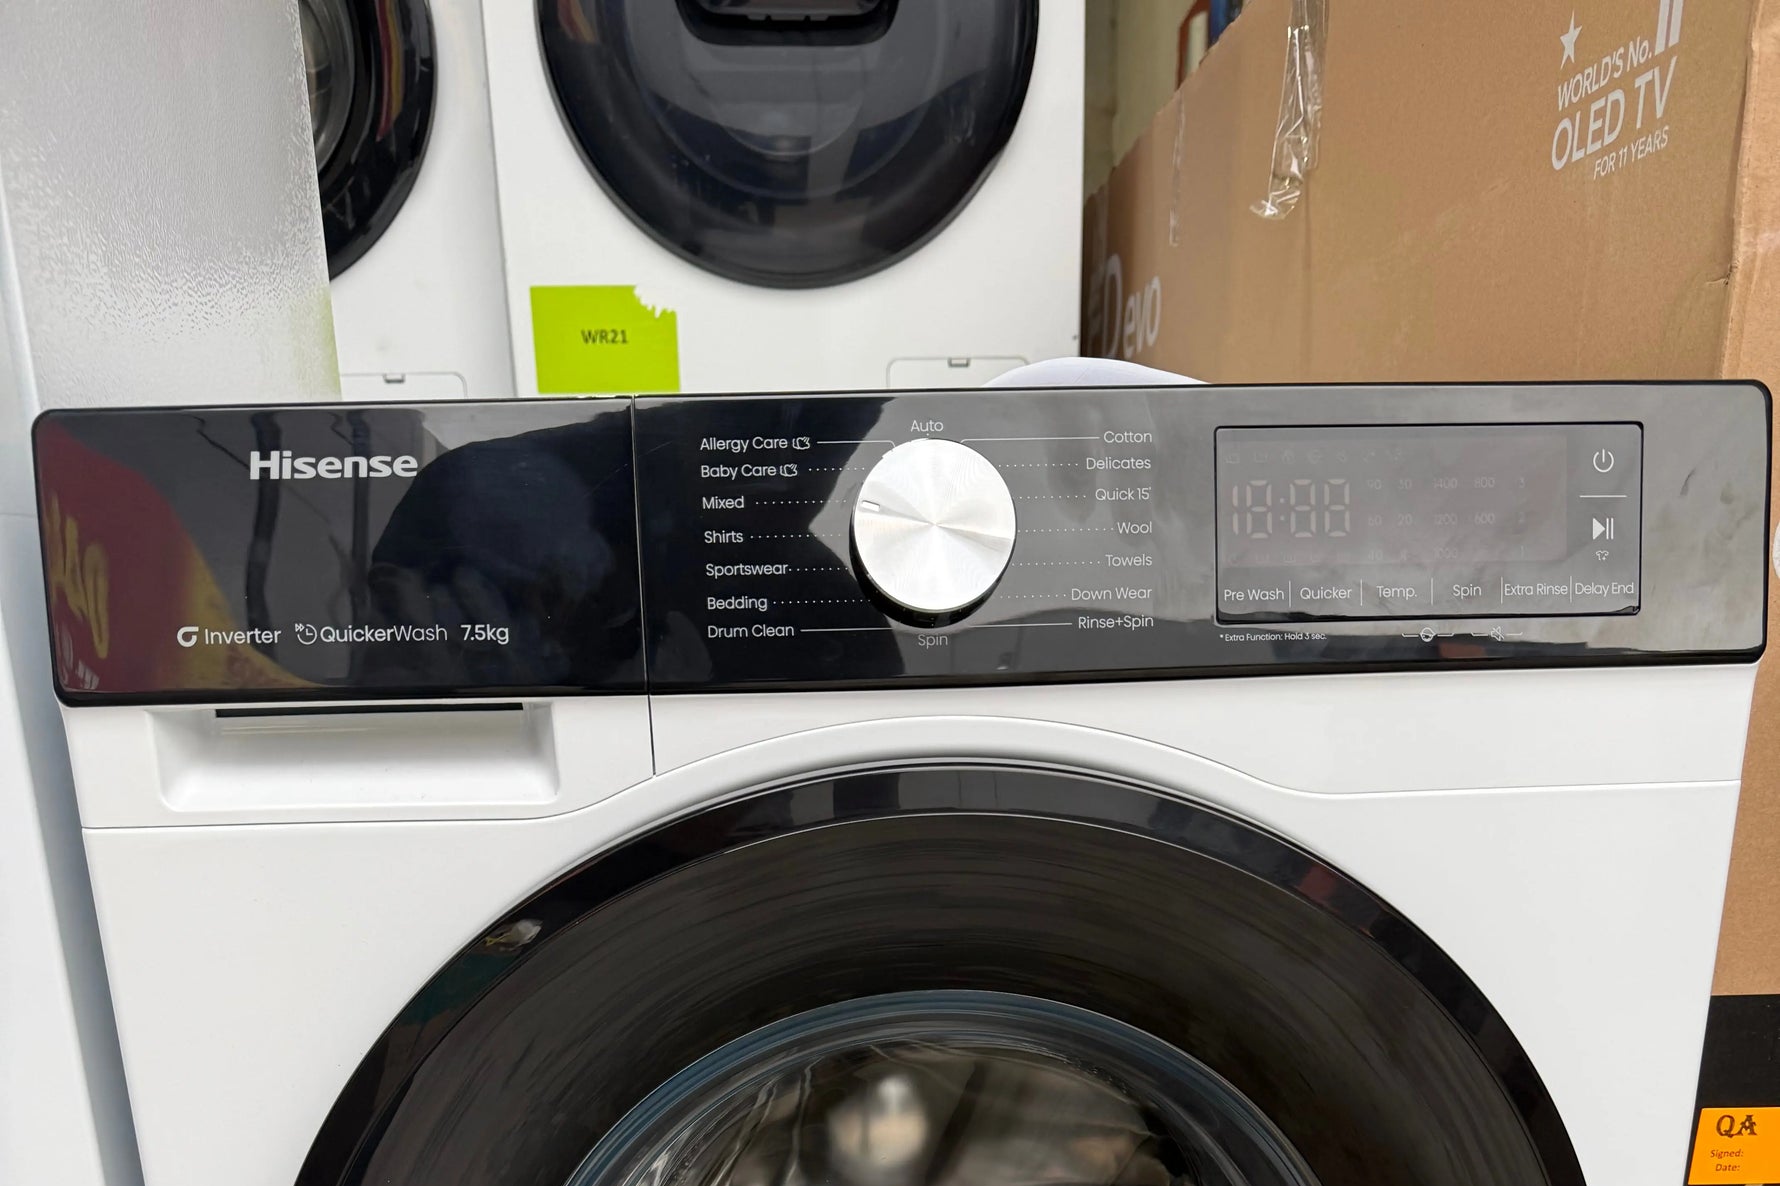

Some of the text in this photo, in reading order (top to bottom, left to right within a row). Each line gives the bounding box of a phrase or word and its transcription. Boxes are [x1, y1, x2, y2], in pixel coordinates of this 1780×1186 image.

[1558, 46, 1625, 111] WORLD'S
[1627, 35, 1652, 72] No.
[1551, 55, 1678, 171] OLED TV
[1593, 125, 1669, 180] FOR 11 YEARS
[1123, 275, 1162, 359] evo
[581, 329, 628, 344] WR21
[910, 420, 944, 432] Auto
[1103, 431, 1152, 443] Cotton
[700, 437, 788, 453] Allergy Care
[250, 450, 419, 480] Hisense
[1086, 456, 1151, 470] Delicates
[701, 464, 777, 480] Baby Care
[1095, 487, 1135, 501] Quick
[702, 496, 744, 509] Mixed
[1117, 521, 1152, 534] Wool
[704, 530, 744, 544] Shirts
[1105, 554, 1153, 567] Towels
[706, 563, 789, 579] Sportswear
[1071, 587, 1153, 601] Down Wear
[1224, 588, 1285, 601] Pre Wash
[1300, 587, 1352, 599] Quicker
[1376, 585, 1417, 600] Temp.
[1452, 584, 1482, 600] Spin
[1504, 583, 1568, 596] Extra Rinse
[1575, 582, 1634, 597] Delay End
[707, 595, 768, 612] Bedding
[1078, 614, 1154, 631] Rinse+Spin
[204, 624, 509, 645] Inverter QuickerWash 7.5kg
[708, 624, 794, 638] Drum Clean
[1246, 633, 1283, 641] Function:
[1284, 633, 1303, 641] Hold
[918, 634, 948, 650] Spin
[1715, 1114, 1757, 1138] QA
[1710, 1149, 1744, 1159] Signed:
[1715, 1163, 1741, 1172] Date:
